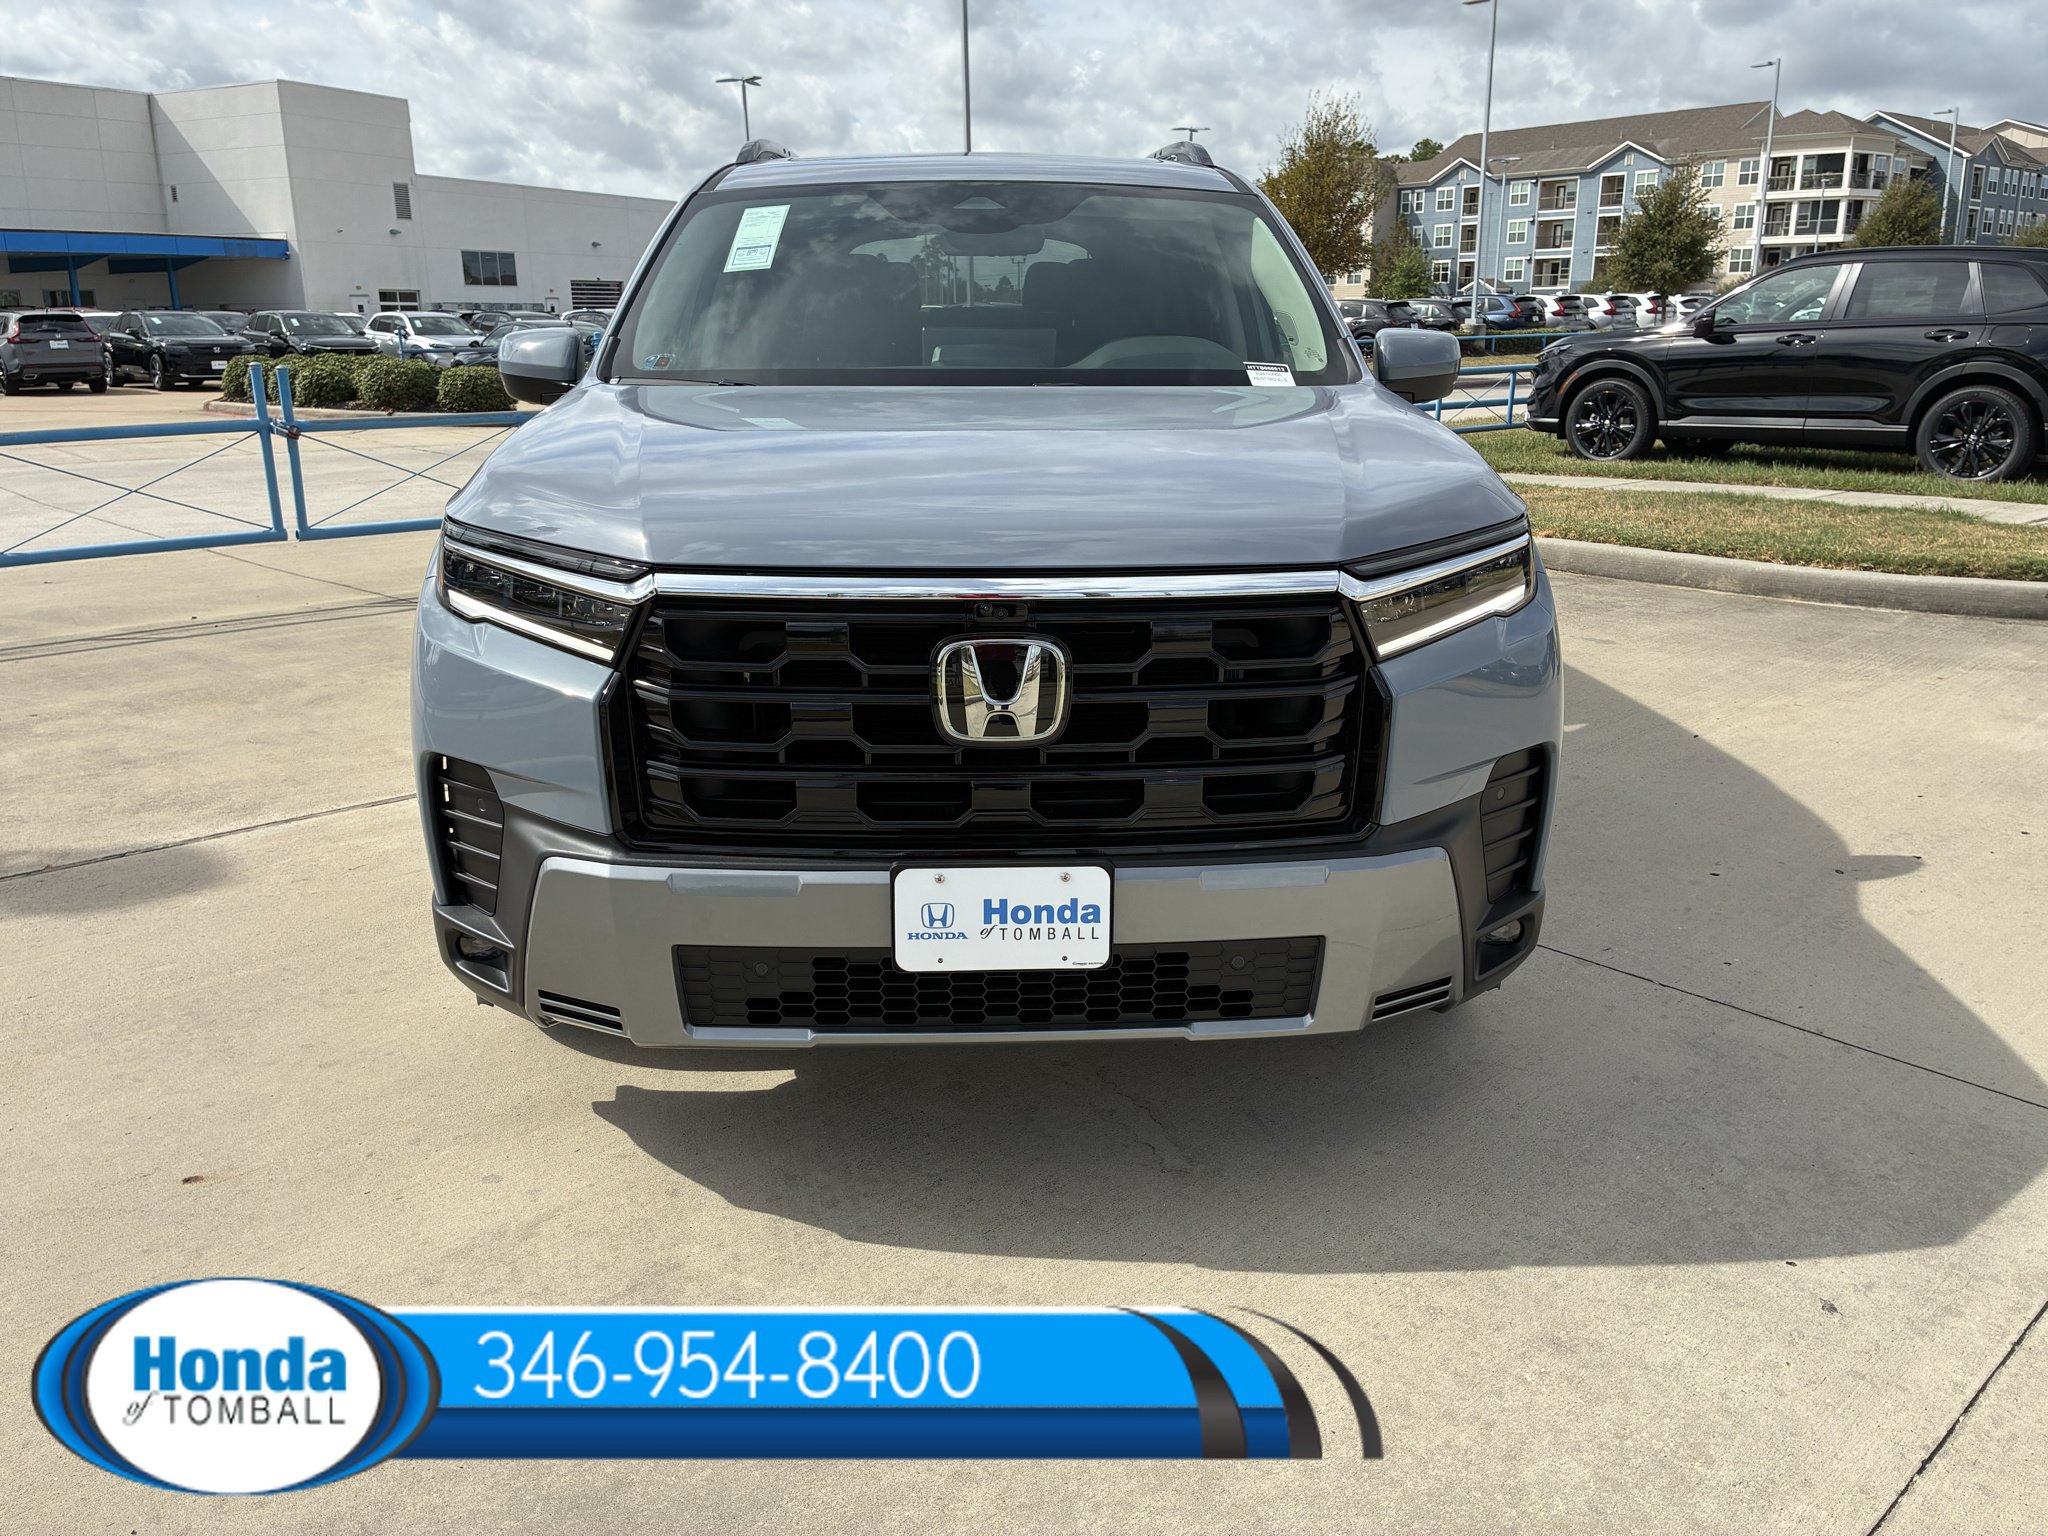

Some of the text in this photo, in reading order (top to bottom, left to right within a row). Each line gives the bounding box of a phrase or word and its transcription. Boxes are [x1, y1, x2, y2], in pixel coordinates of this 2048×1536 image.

[984, 898, 1101, 925] Honda
[907, 931, 968, 940] HONDA
[980, 925, 1100, 941] of TOMBALL
